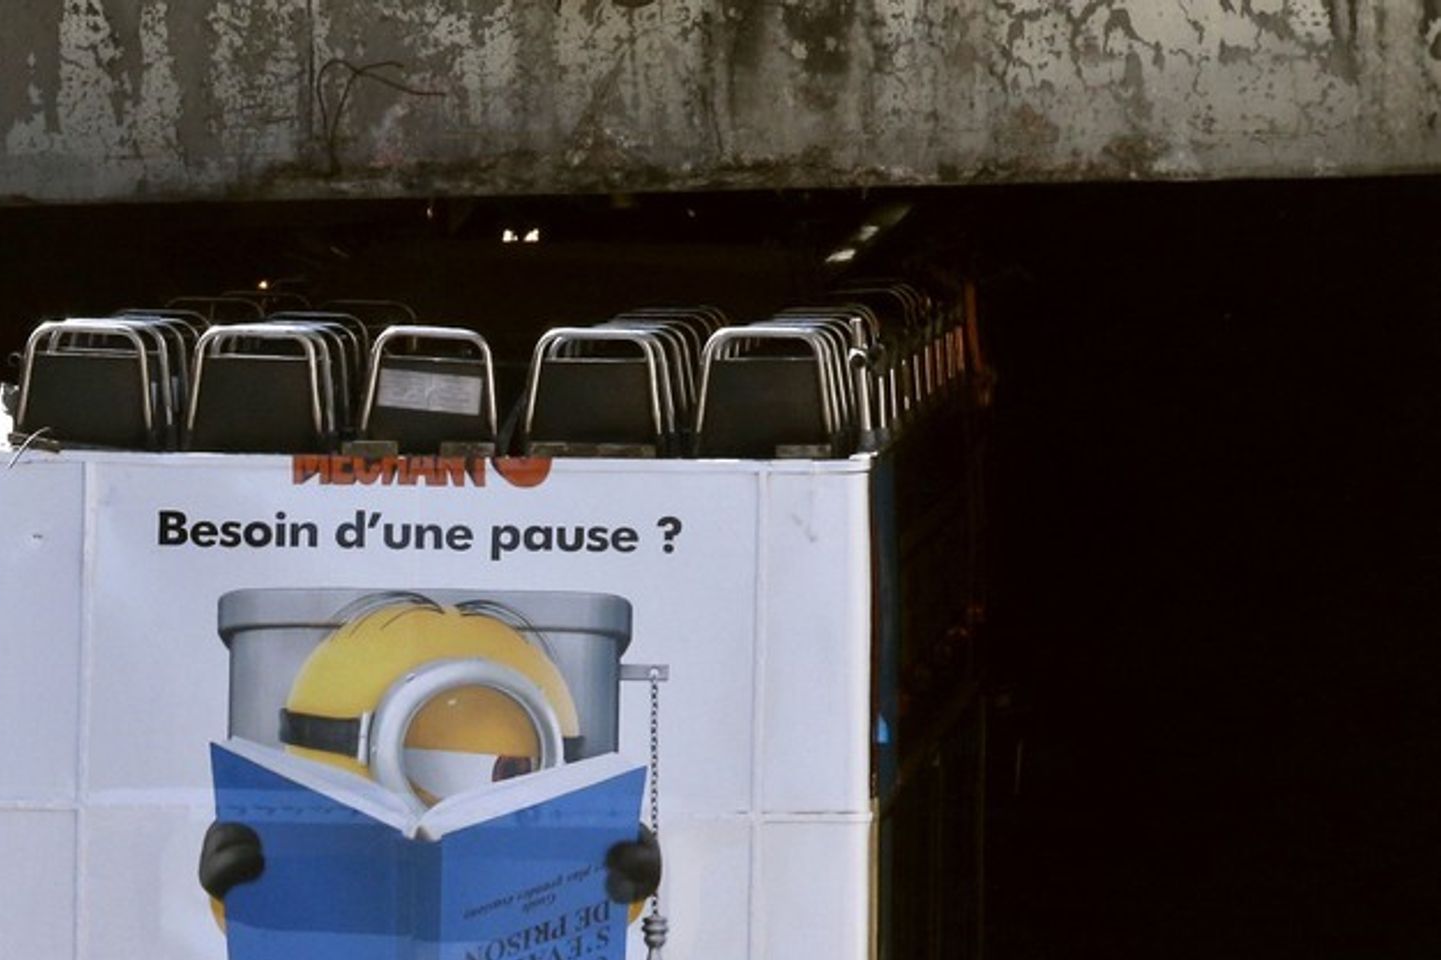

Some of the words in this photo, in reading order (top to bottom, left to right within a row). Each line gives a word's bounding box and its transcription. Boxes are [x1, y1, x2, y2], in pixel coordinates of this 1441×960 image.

[157, 511, 319, 548] Besoin
[335, 511, 474, 551] d'une
[491, 523, 640, 561] pause
[657, 516, 683, 554] ?
[574, 900, 610, 926] DE
